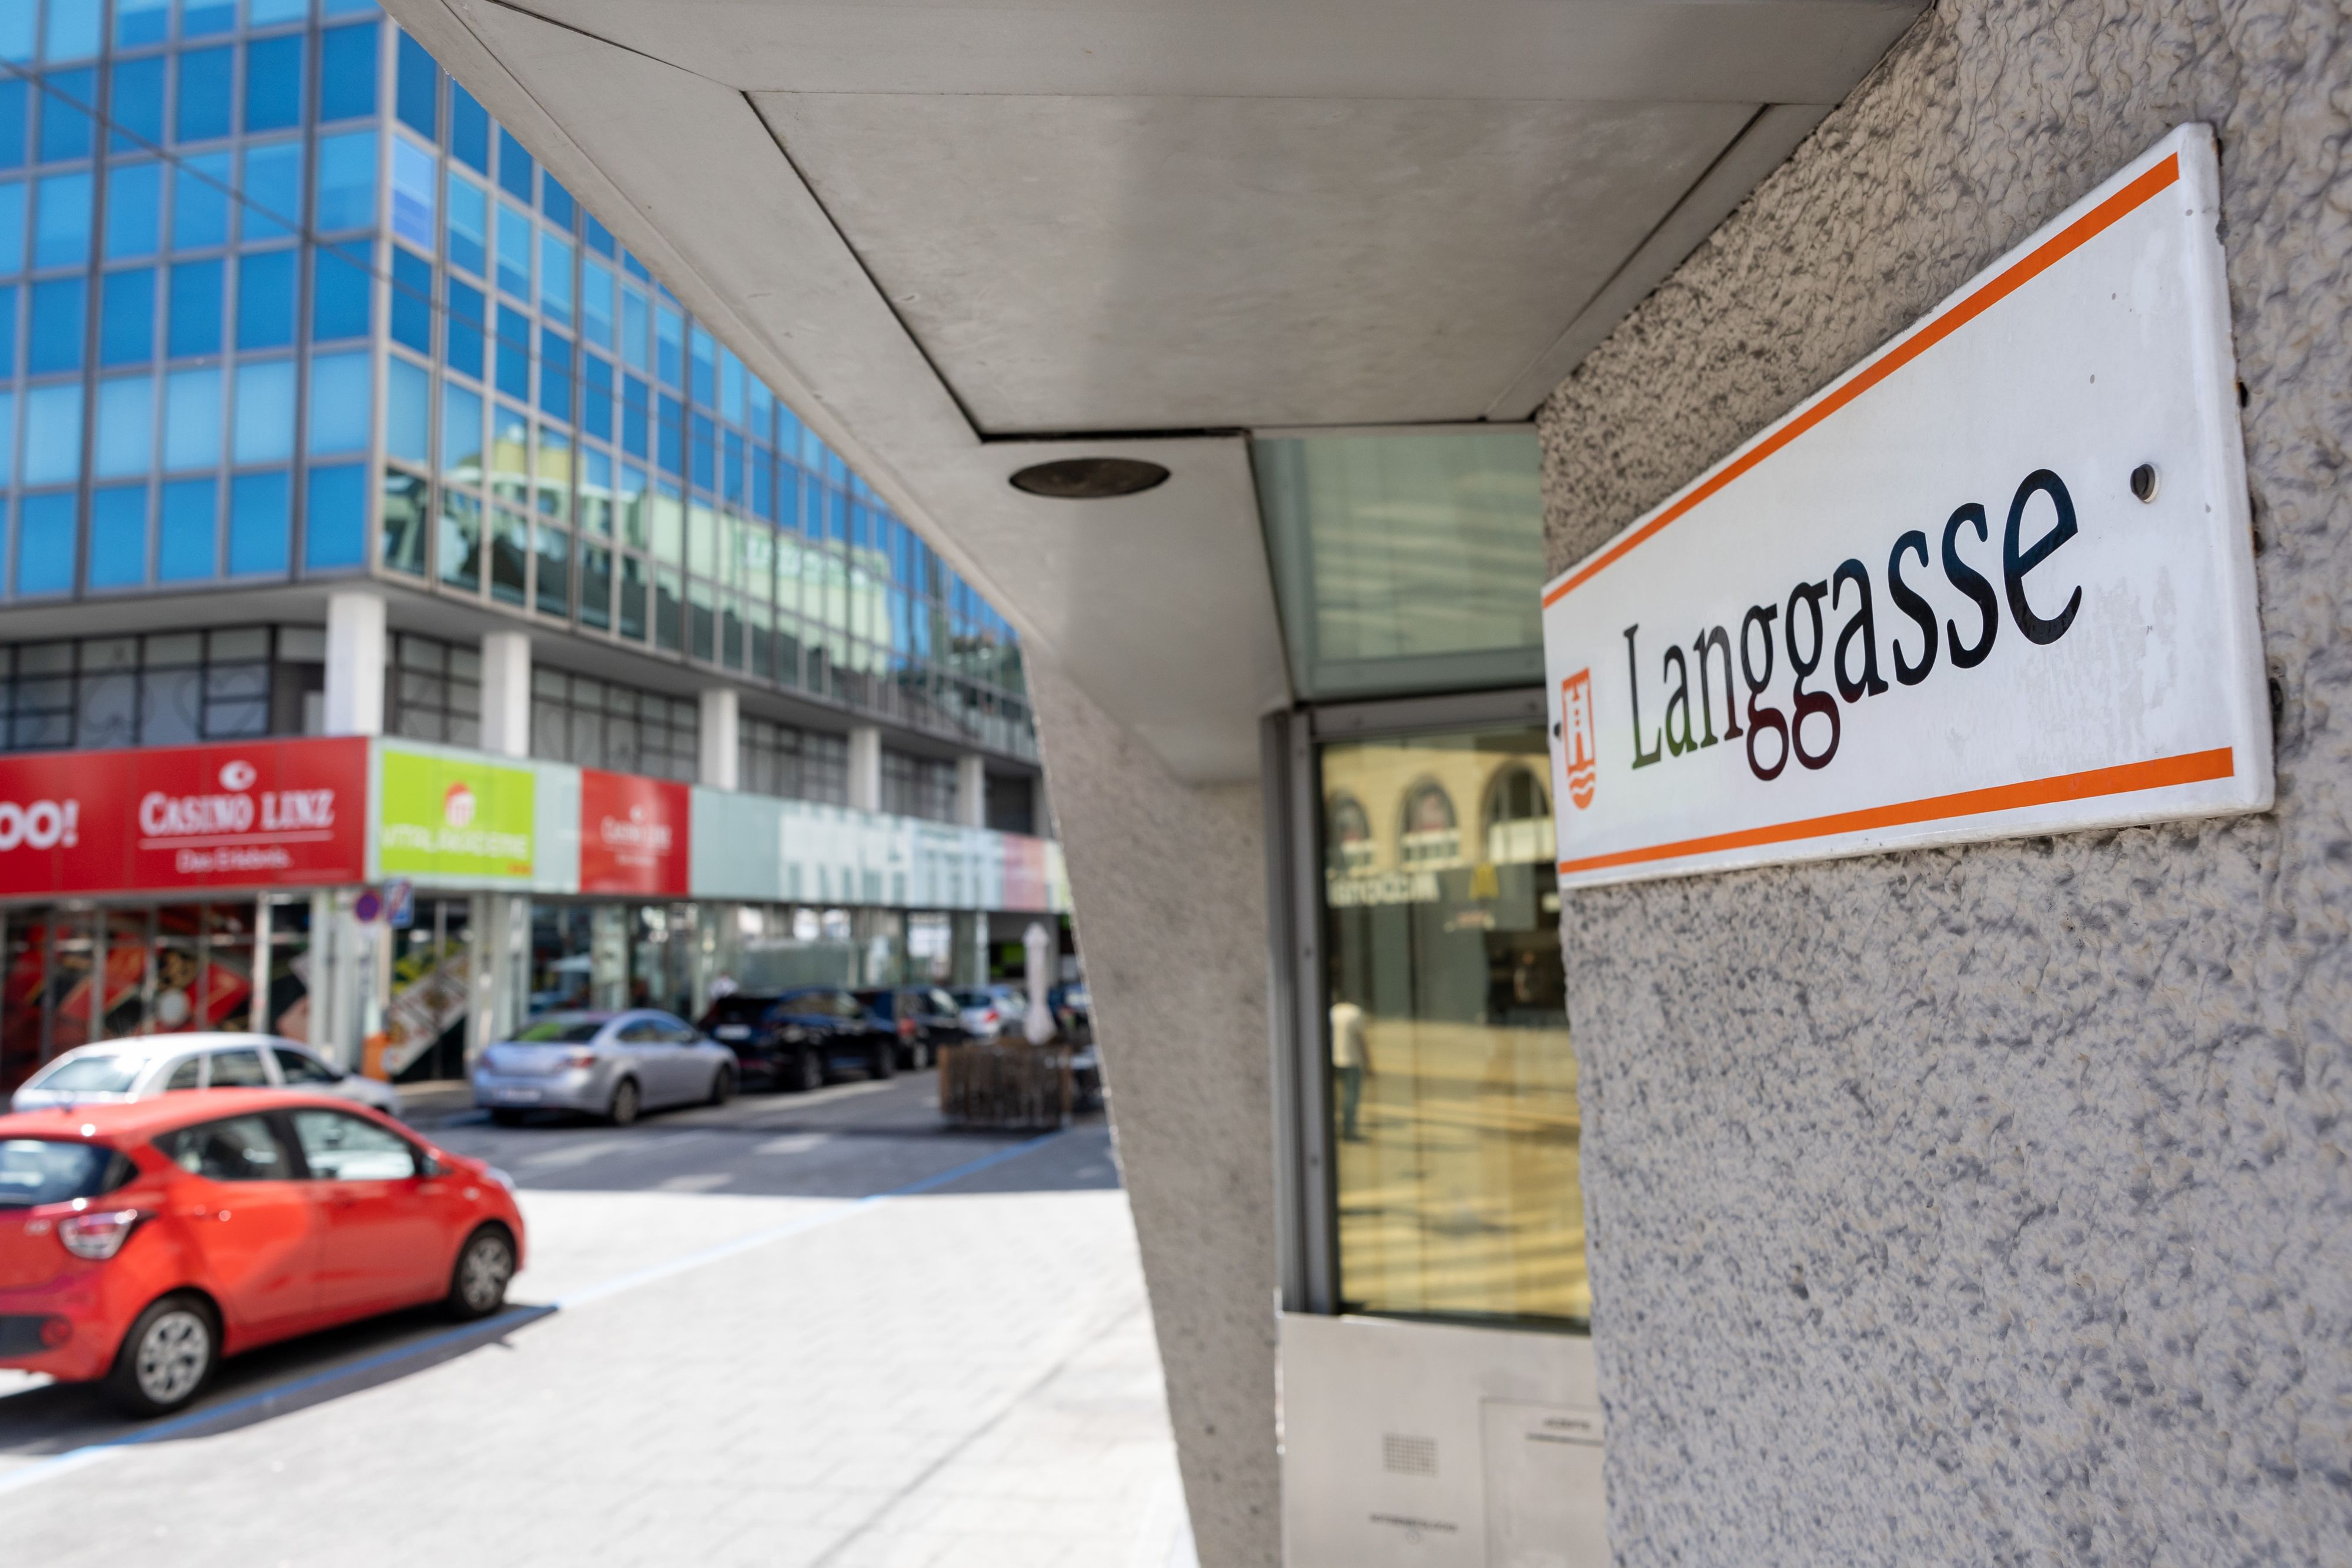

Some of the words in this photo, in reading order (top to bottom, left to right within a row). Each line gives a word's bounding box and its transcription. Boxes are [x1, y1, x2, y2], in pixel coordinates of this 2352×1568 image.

[1623, 468, 2083, 782] Langgasse
[139, 791, 255, 837] CASINO
[260, 789, 335, 831] LINZ
